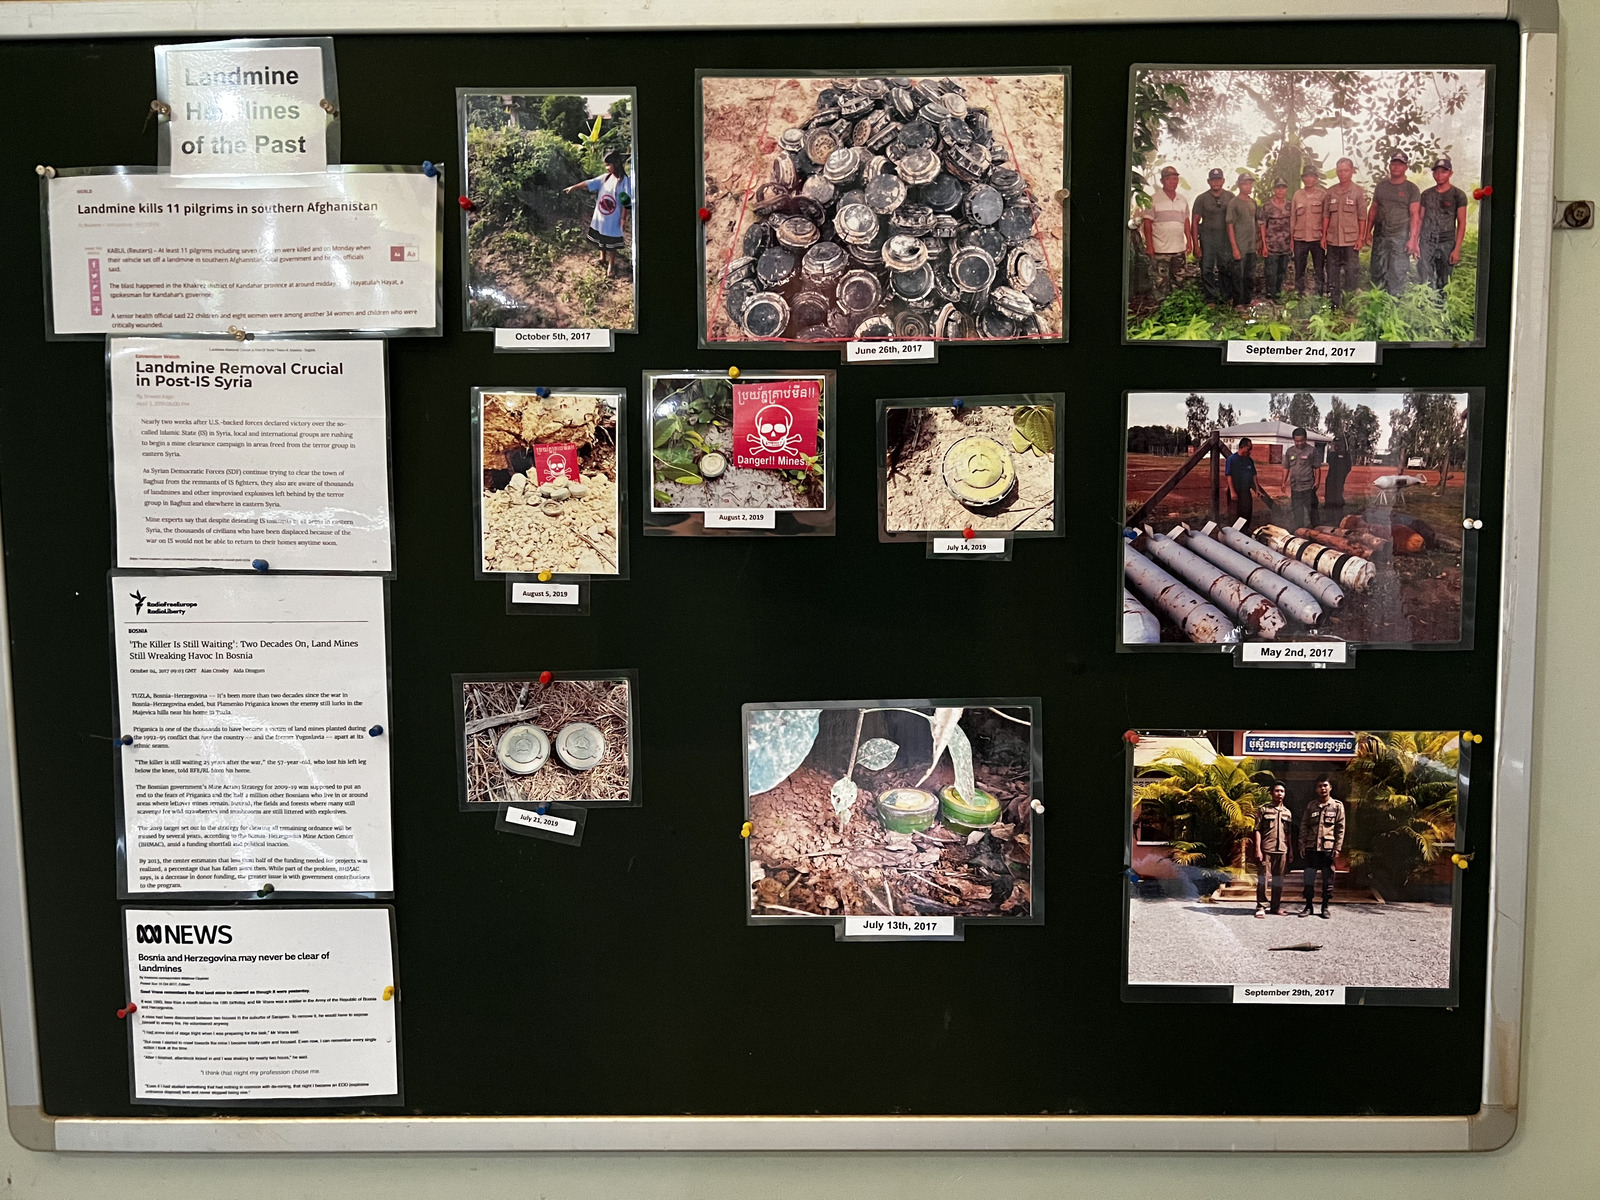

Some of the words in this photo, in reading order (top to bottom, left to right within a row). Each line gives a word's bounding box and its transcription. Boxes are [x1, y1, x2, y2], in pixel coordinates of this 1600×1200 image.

[185, 66, 299, 86] Landmine
[186, 102, 300, 120] Hlines
[181, 136, 204, 154] of
[212, 136, 246, 154] the
[255, 135, 306, 154] Past
[78, 203, 135, 214] Landmine
[138, 203, 162, 213] kills
[168, 203, 178, 212] 11
[184, 203, 233, 216] pilgrims
[237, 203, 247, 213] in
[251, 203, 303, 213] southern
[307, 201, 378, 214] Afghanistan
[515, 332, 550, 340] October
[552, 332, 568, 340] 5th,
[878, 345, 899, 353] 26th,
[902, 344, 921, 352] 2017
[1246, 344, 1302, 355] September
[1305, 346, 1327, 356] 2nd,
[1331, 347, 1355, 356] 2017
[136, 361, 215, 374] Landmine
[220, 362, 286, 374] Removal
[291, 362, 342, 374] Crucial
[136, 373, 150, 386] in
[155, 375, 209, 387] Post-IS
[214, 375, 251, 390] Syria
[737, 456, 775, 466] Danger!!
[173, 640, 181, 648] Is
[294, 639, 309, 648] On,
[311, 639, 331, 647] Land
[147, 652, 186, 660] Wreaking
[1260, 647, 1281, 658] May
[1284, 647, 1306, 657] 2nd,
[1309, 648, 1332, 656] 2017
[520, 814, 532, 822] July
[533, 816, 542, 824] 21,
[543, 818, 558, 827] 2019
[862, 920, 884, 930] July
[887, 921, 911, 930] 13th,
[913, 921, 937, 930] 2017
[165, 925, 232, 944] NEWS
[138, 953, 165, 961] Bosnia
[184, 954, 236, 963] Herzegovina
[284, 952, 295, 960] be
[321, 951, 329, 959] of
[138, 964, 182, 972] landmines
[1244, 988, 1290, 996] September
[1291, 988, 1312, 996] 29th,
